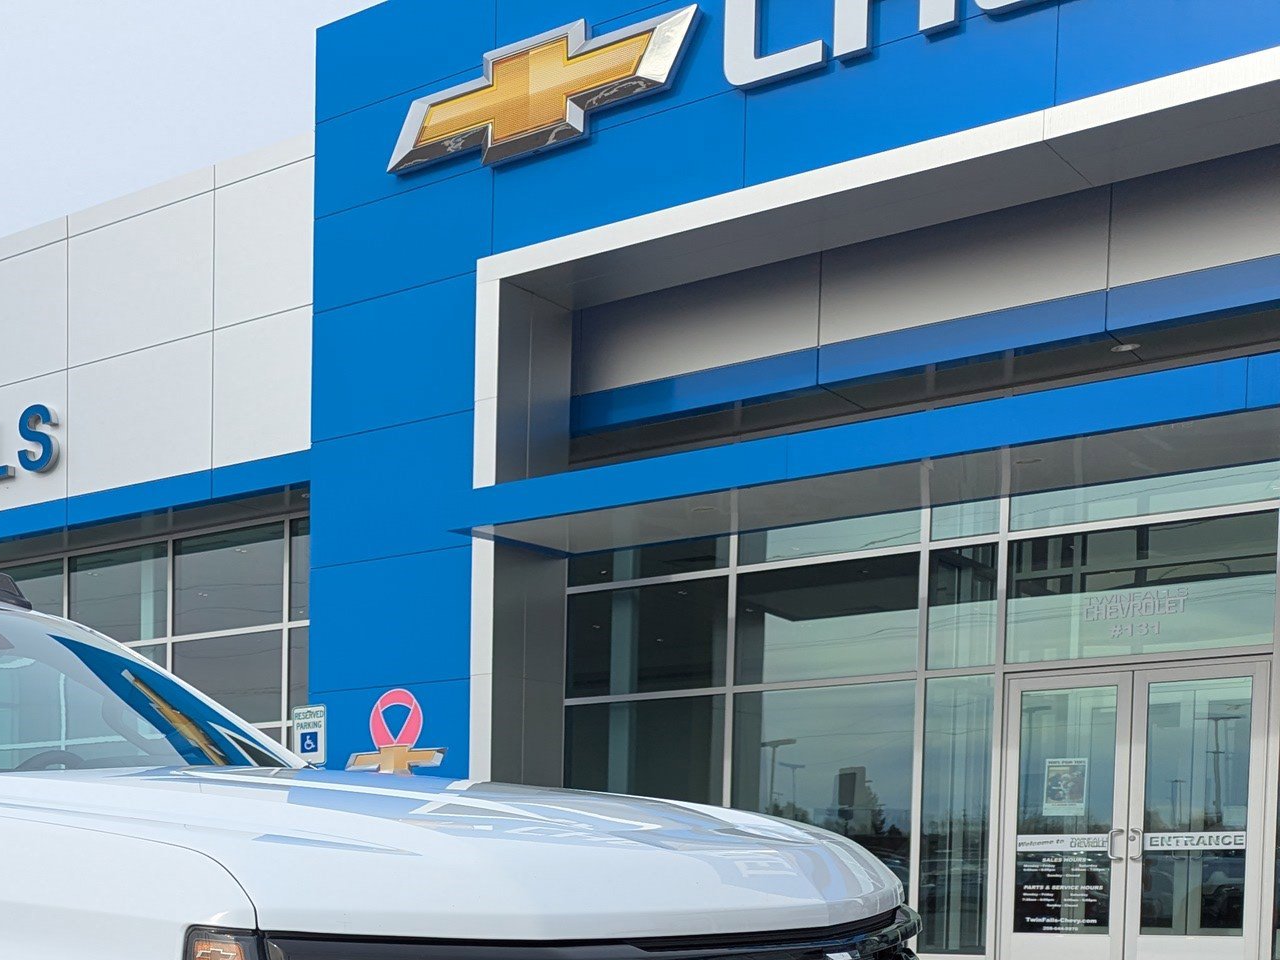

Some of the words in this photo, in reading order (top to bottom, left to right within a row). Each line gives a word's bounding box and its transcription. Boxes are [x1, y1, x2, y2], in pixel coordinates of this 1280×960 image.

[1084, 598, 1185, 622] CHEVROLET
[294, 709, 324, 720] RESERVED
[295, 720, 322, 730] PARKING
[1018, 840, 1054, 848] Welcome
[1149, 834, 1245, 847] ENTRANCE
